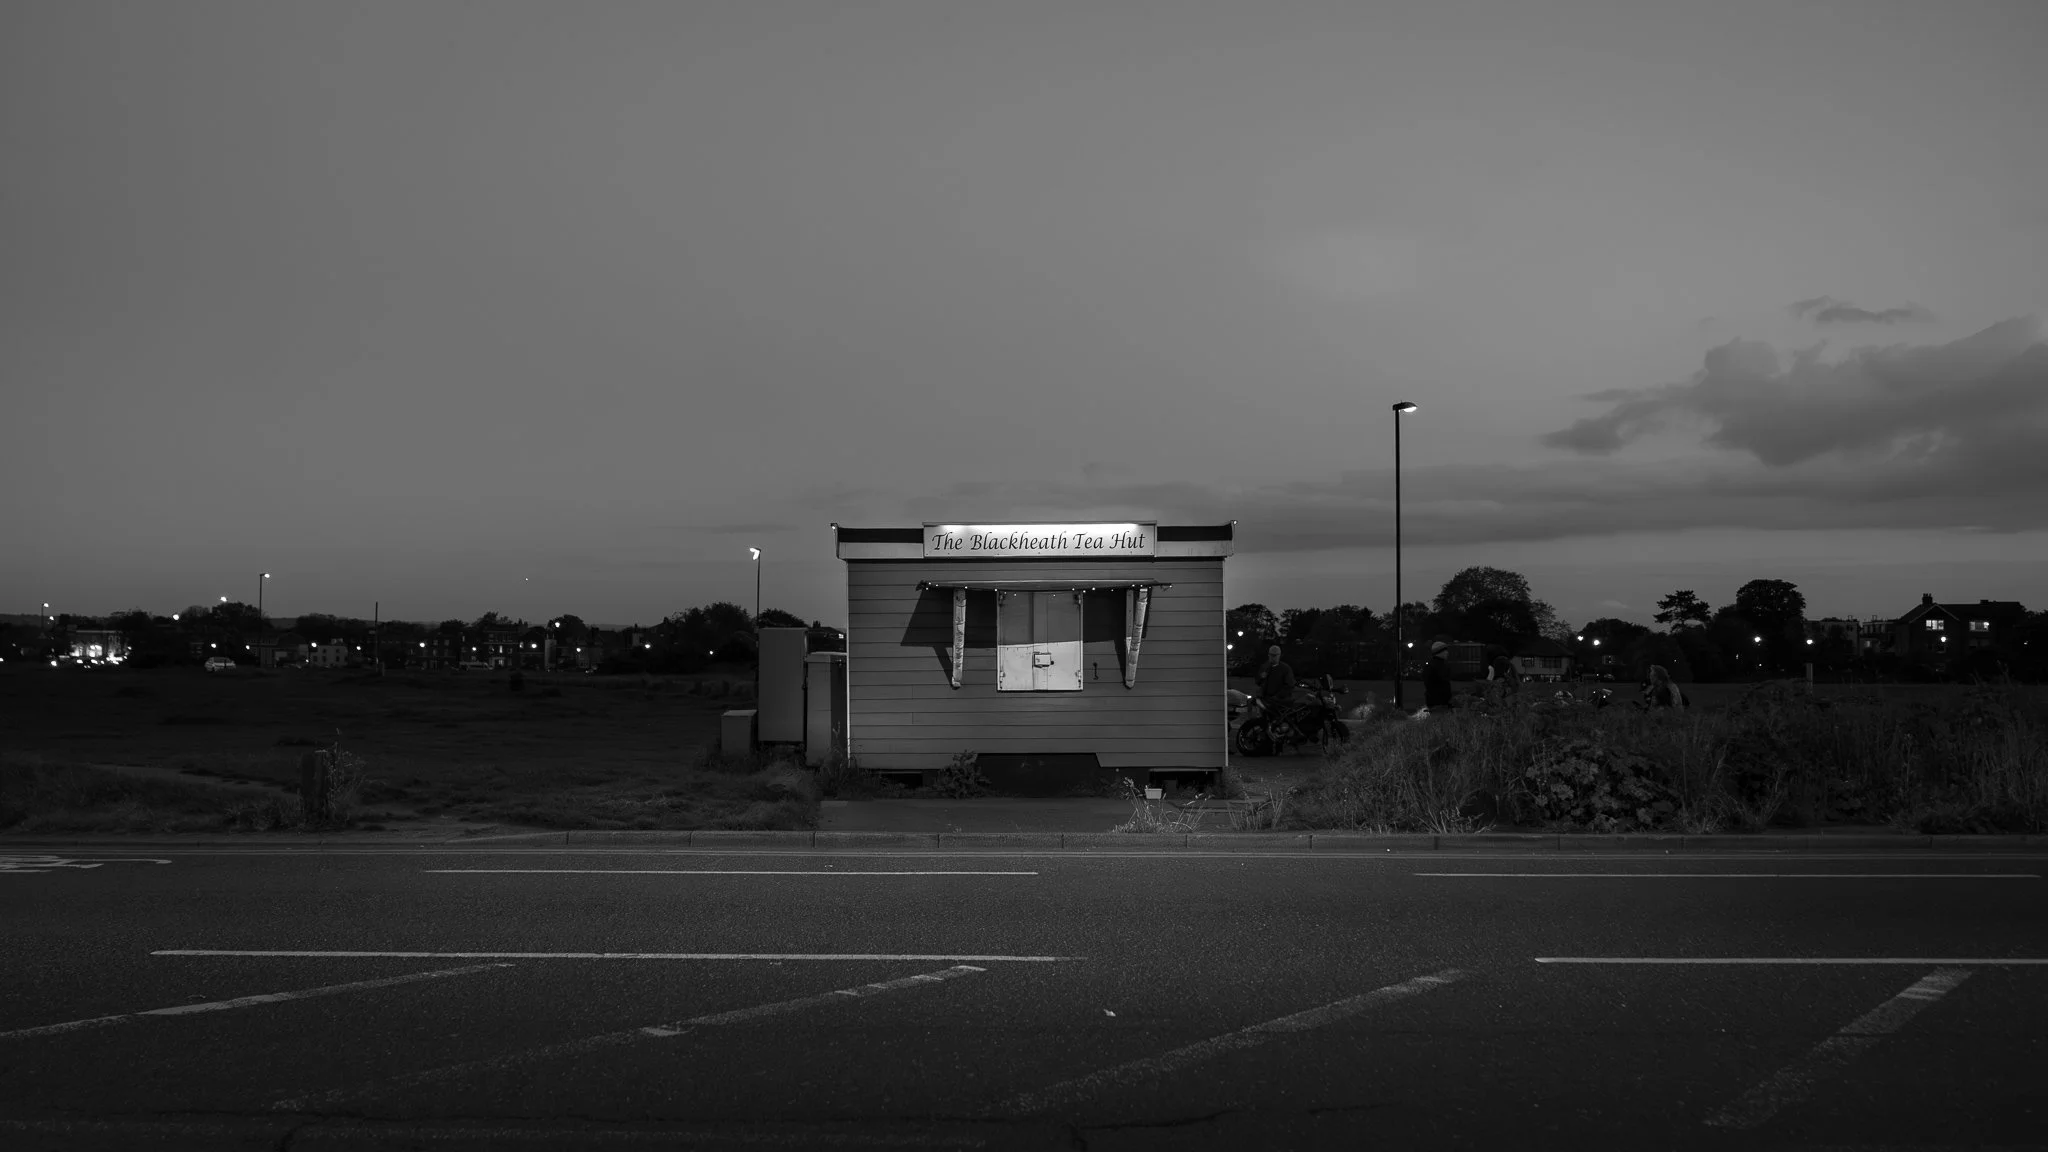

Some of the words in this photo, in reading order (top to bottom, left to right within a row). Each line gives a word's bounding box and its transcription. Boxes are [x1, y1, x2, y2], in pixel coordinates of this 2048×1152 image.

[932, 531, 963, 551] The
[970, 531, 1068, 551] Blackheath
[1073, 532, 1104, 549] Tea
[1109, 531, 1146, 549] Hut
